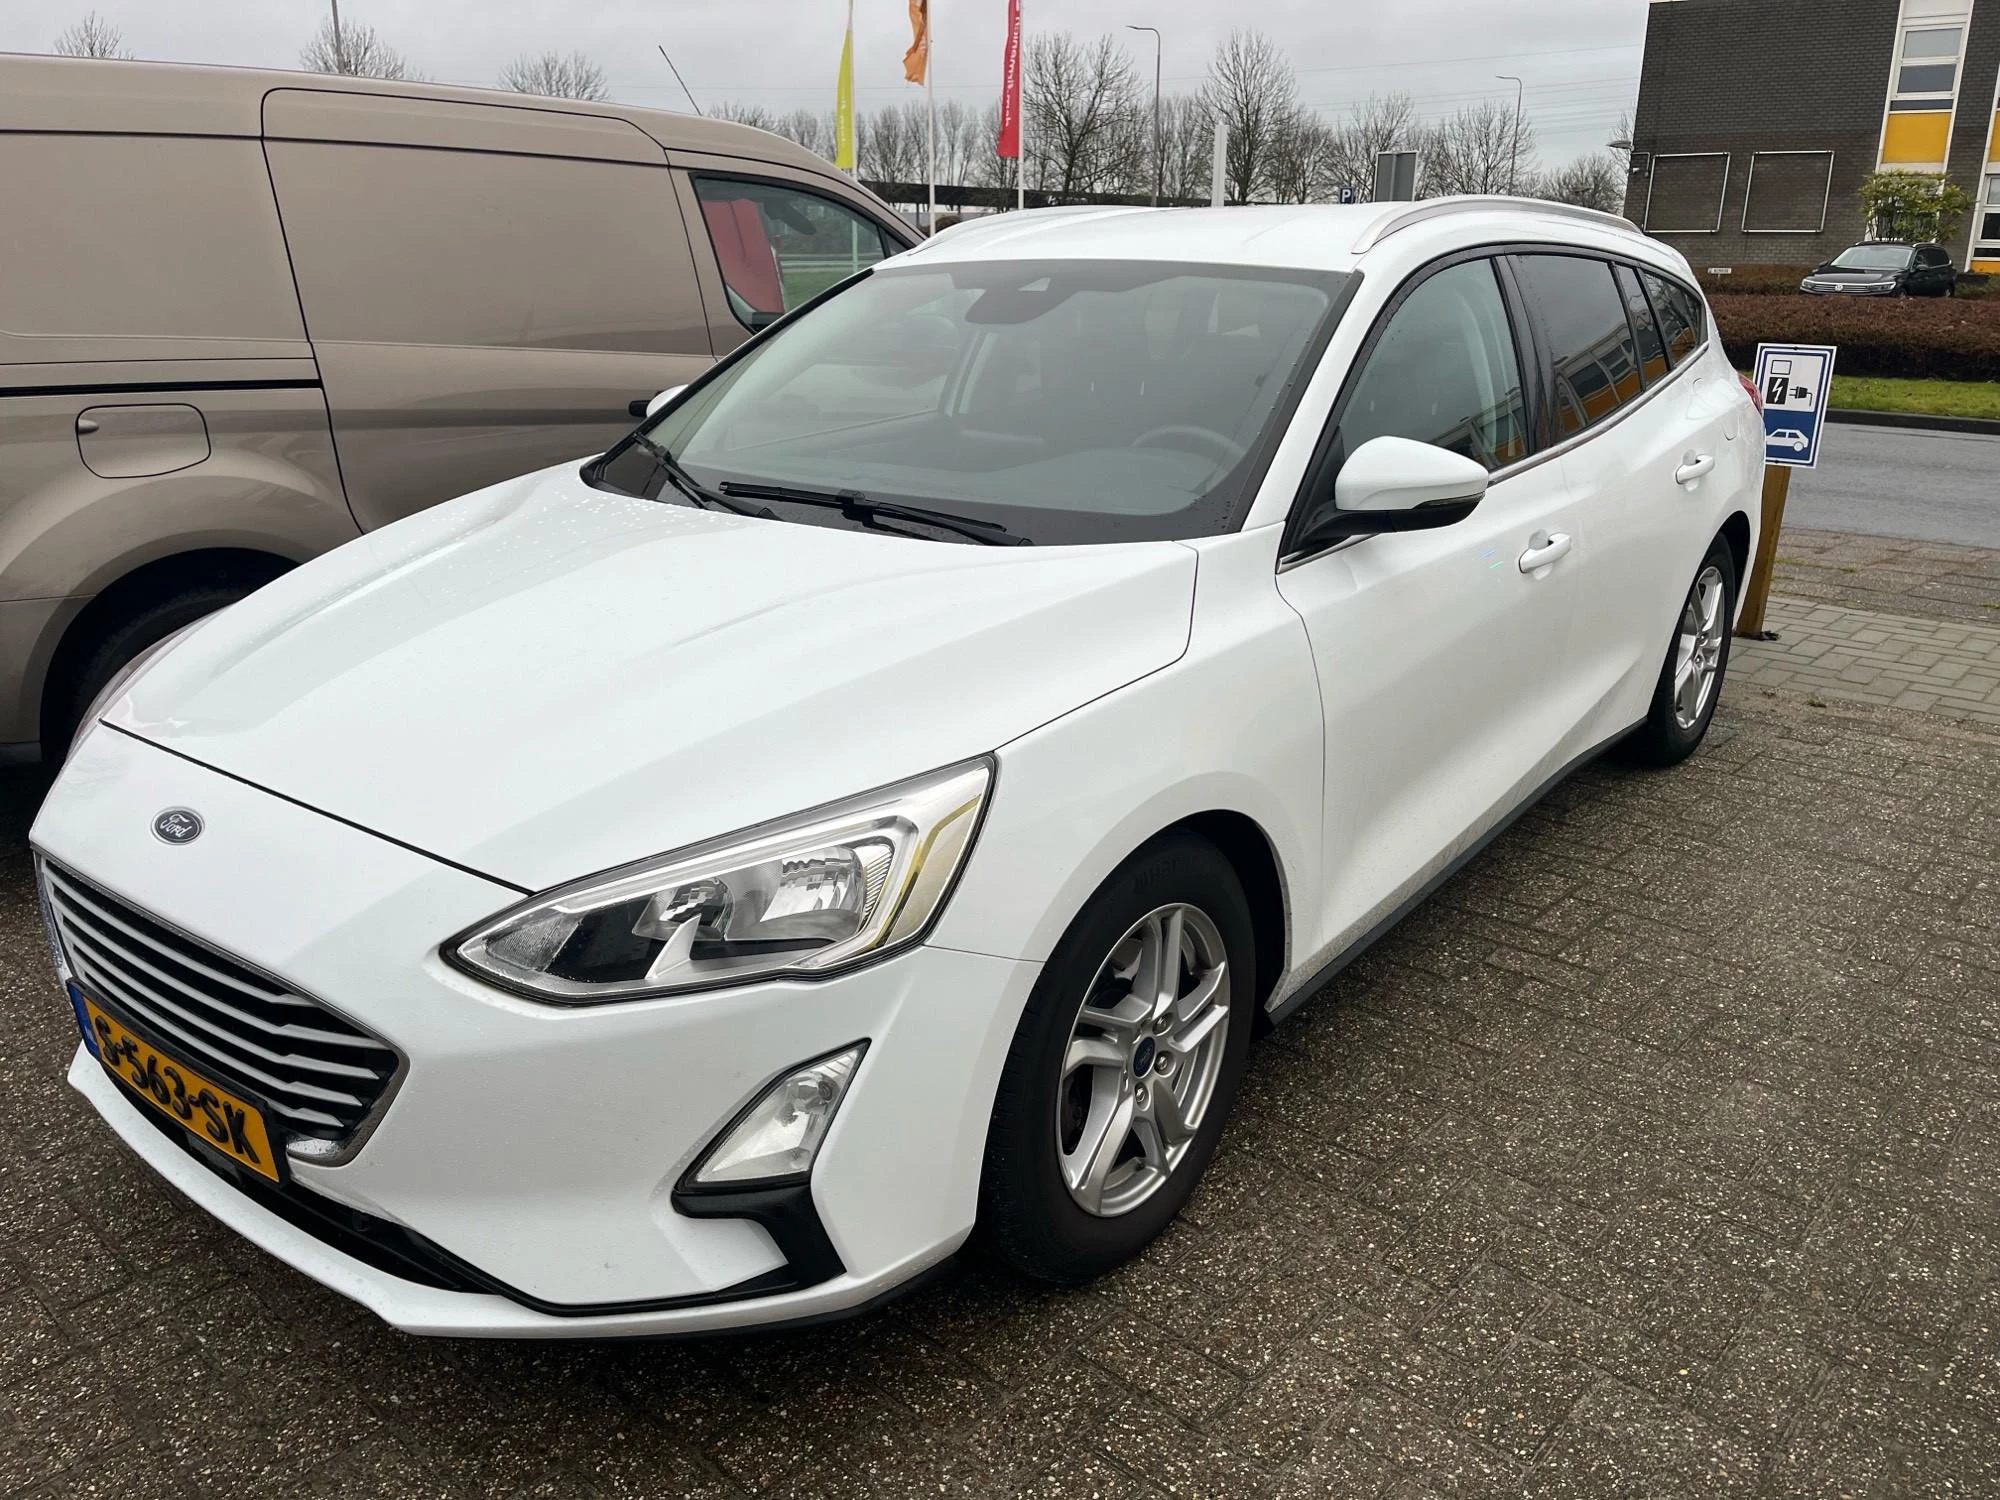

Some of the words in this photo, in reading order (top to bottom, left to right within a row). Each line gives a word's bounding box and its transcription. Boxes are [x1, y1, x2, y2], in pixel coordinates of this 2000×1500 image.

[1342, 189, 1352, 202] P
[160, 813, 192, 838] Ford
[94, 1015, 260, 1155] S-563-SK
